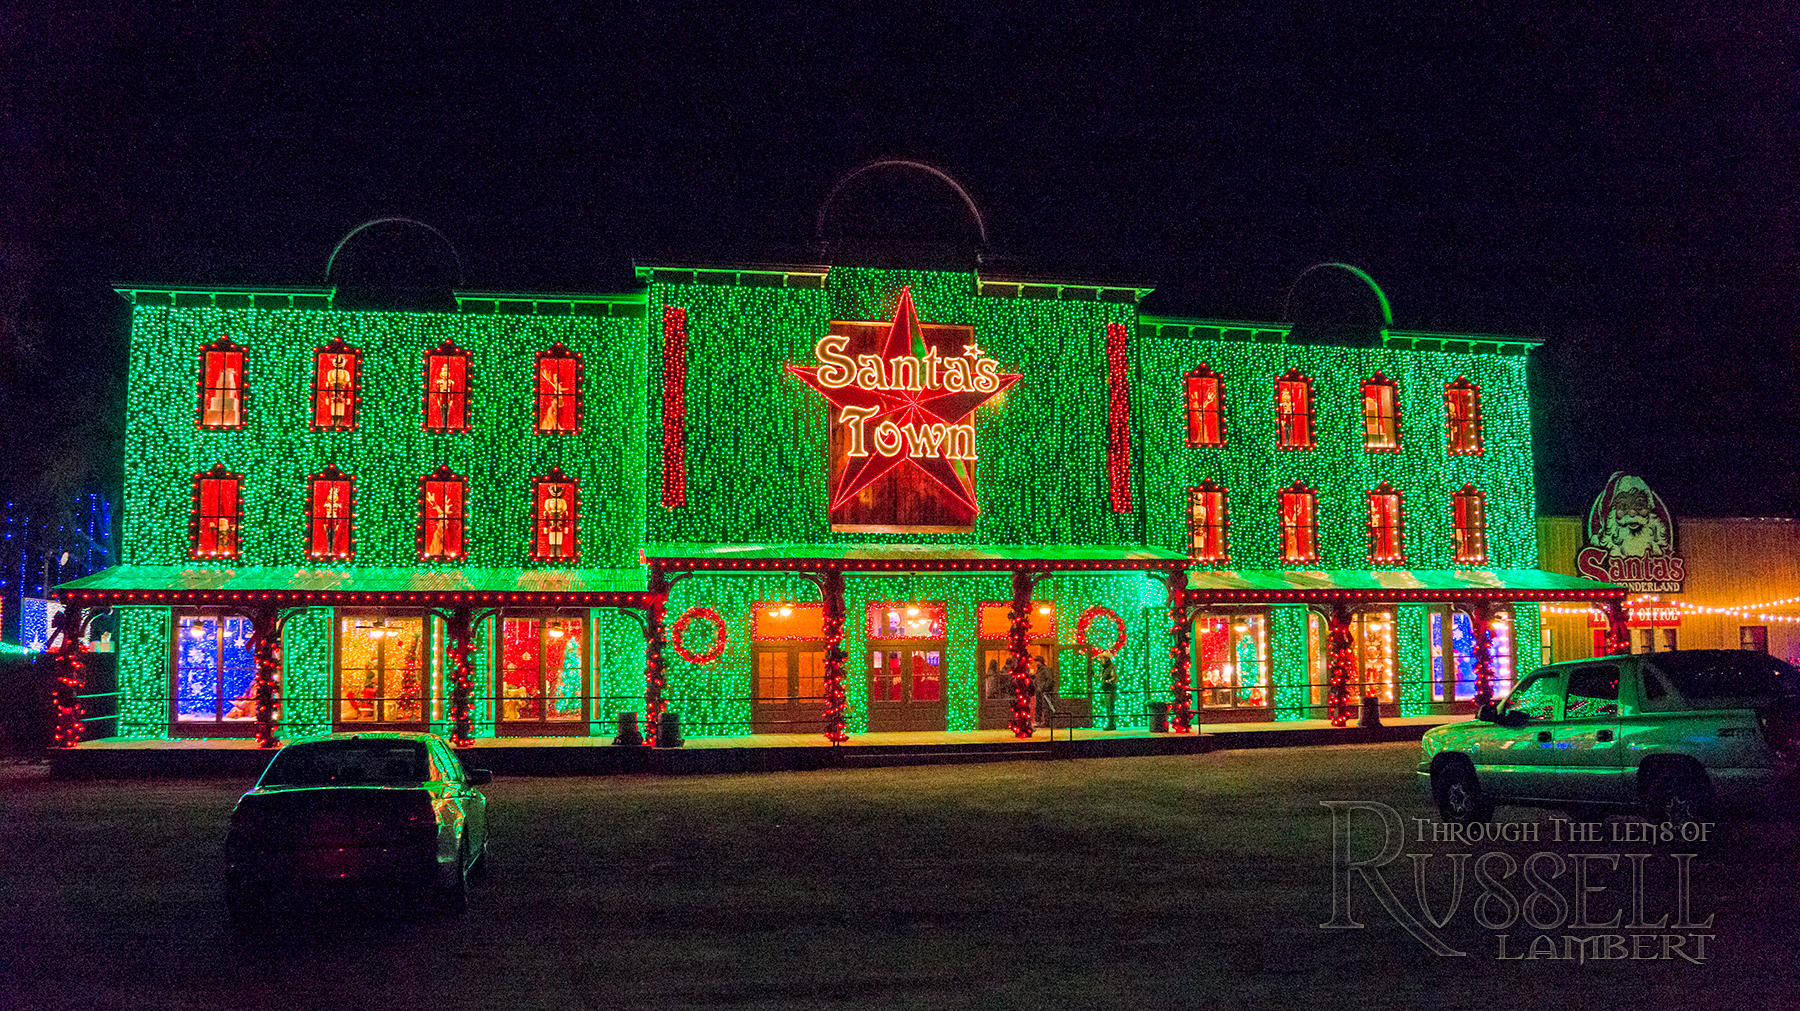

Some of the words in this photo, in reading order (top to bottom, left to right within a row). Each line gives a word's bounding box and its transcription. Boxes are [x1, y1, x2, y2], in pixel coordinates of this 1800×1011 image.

[816, 336, 1000, 392] Santa's
[839, 406, 978, 460] Town
[1577, 547, 1685, 584] Santa's
[1613, 581, 1680, 592] NDERLAND
[1638, 607, 1679, 621] OFFICE
